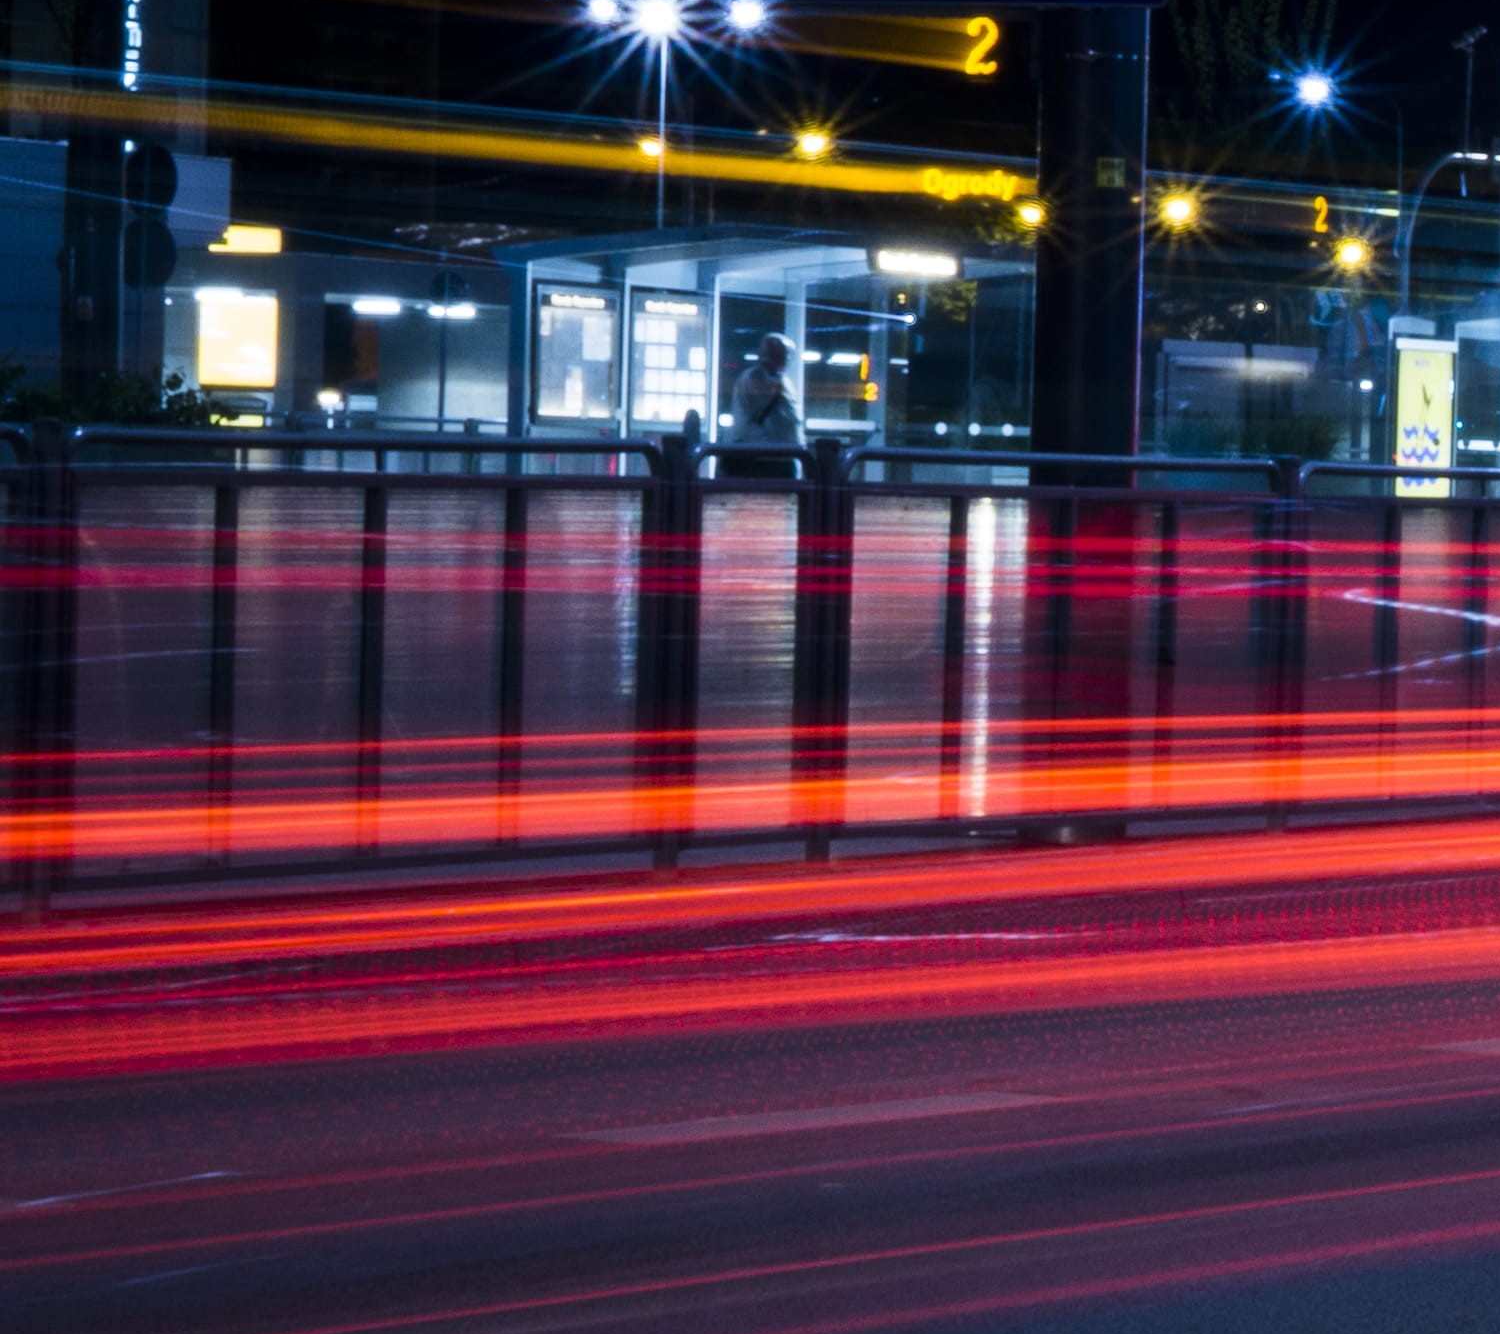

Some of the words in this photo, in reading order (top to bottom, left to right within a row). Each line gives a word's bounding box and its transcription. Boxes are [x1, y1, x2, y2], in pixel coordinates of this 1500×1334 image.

[965, 17, 999, 75] 2
[923, 168, 1018, 201] Ogrody
[1314, 196, 1329, 233] 2
